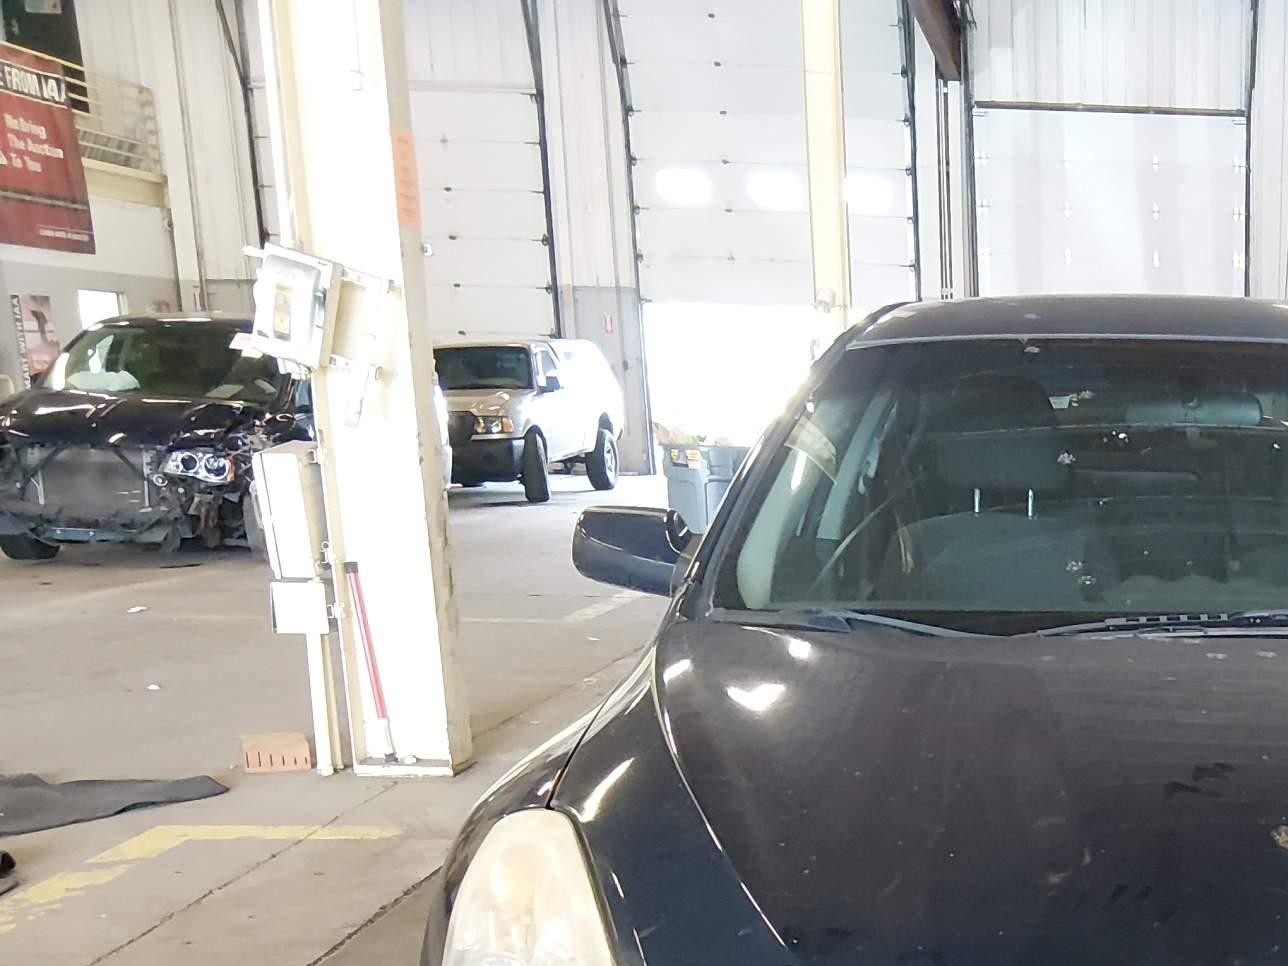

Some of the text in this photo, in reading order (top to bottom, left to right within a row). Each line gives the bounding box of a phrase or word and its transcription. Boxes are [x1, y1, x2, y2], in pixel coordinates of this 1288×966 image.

[4, 66, 41, 97] FROM
[12, 297, 21, 319] IAA
[16, 322, 25, 354] WITH
